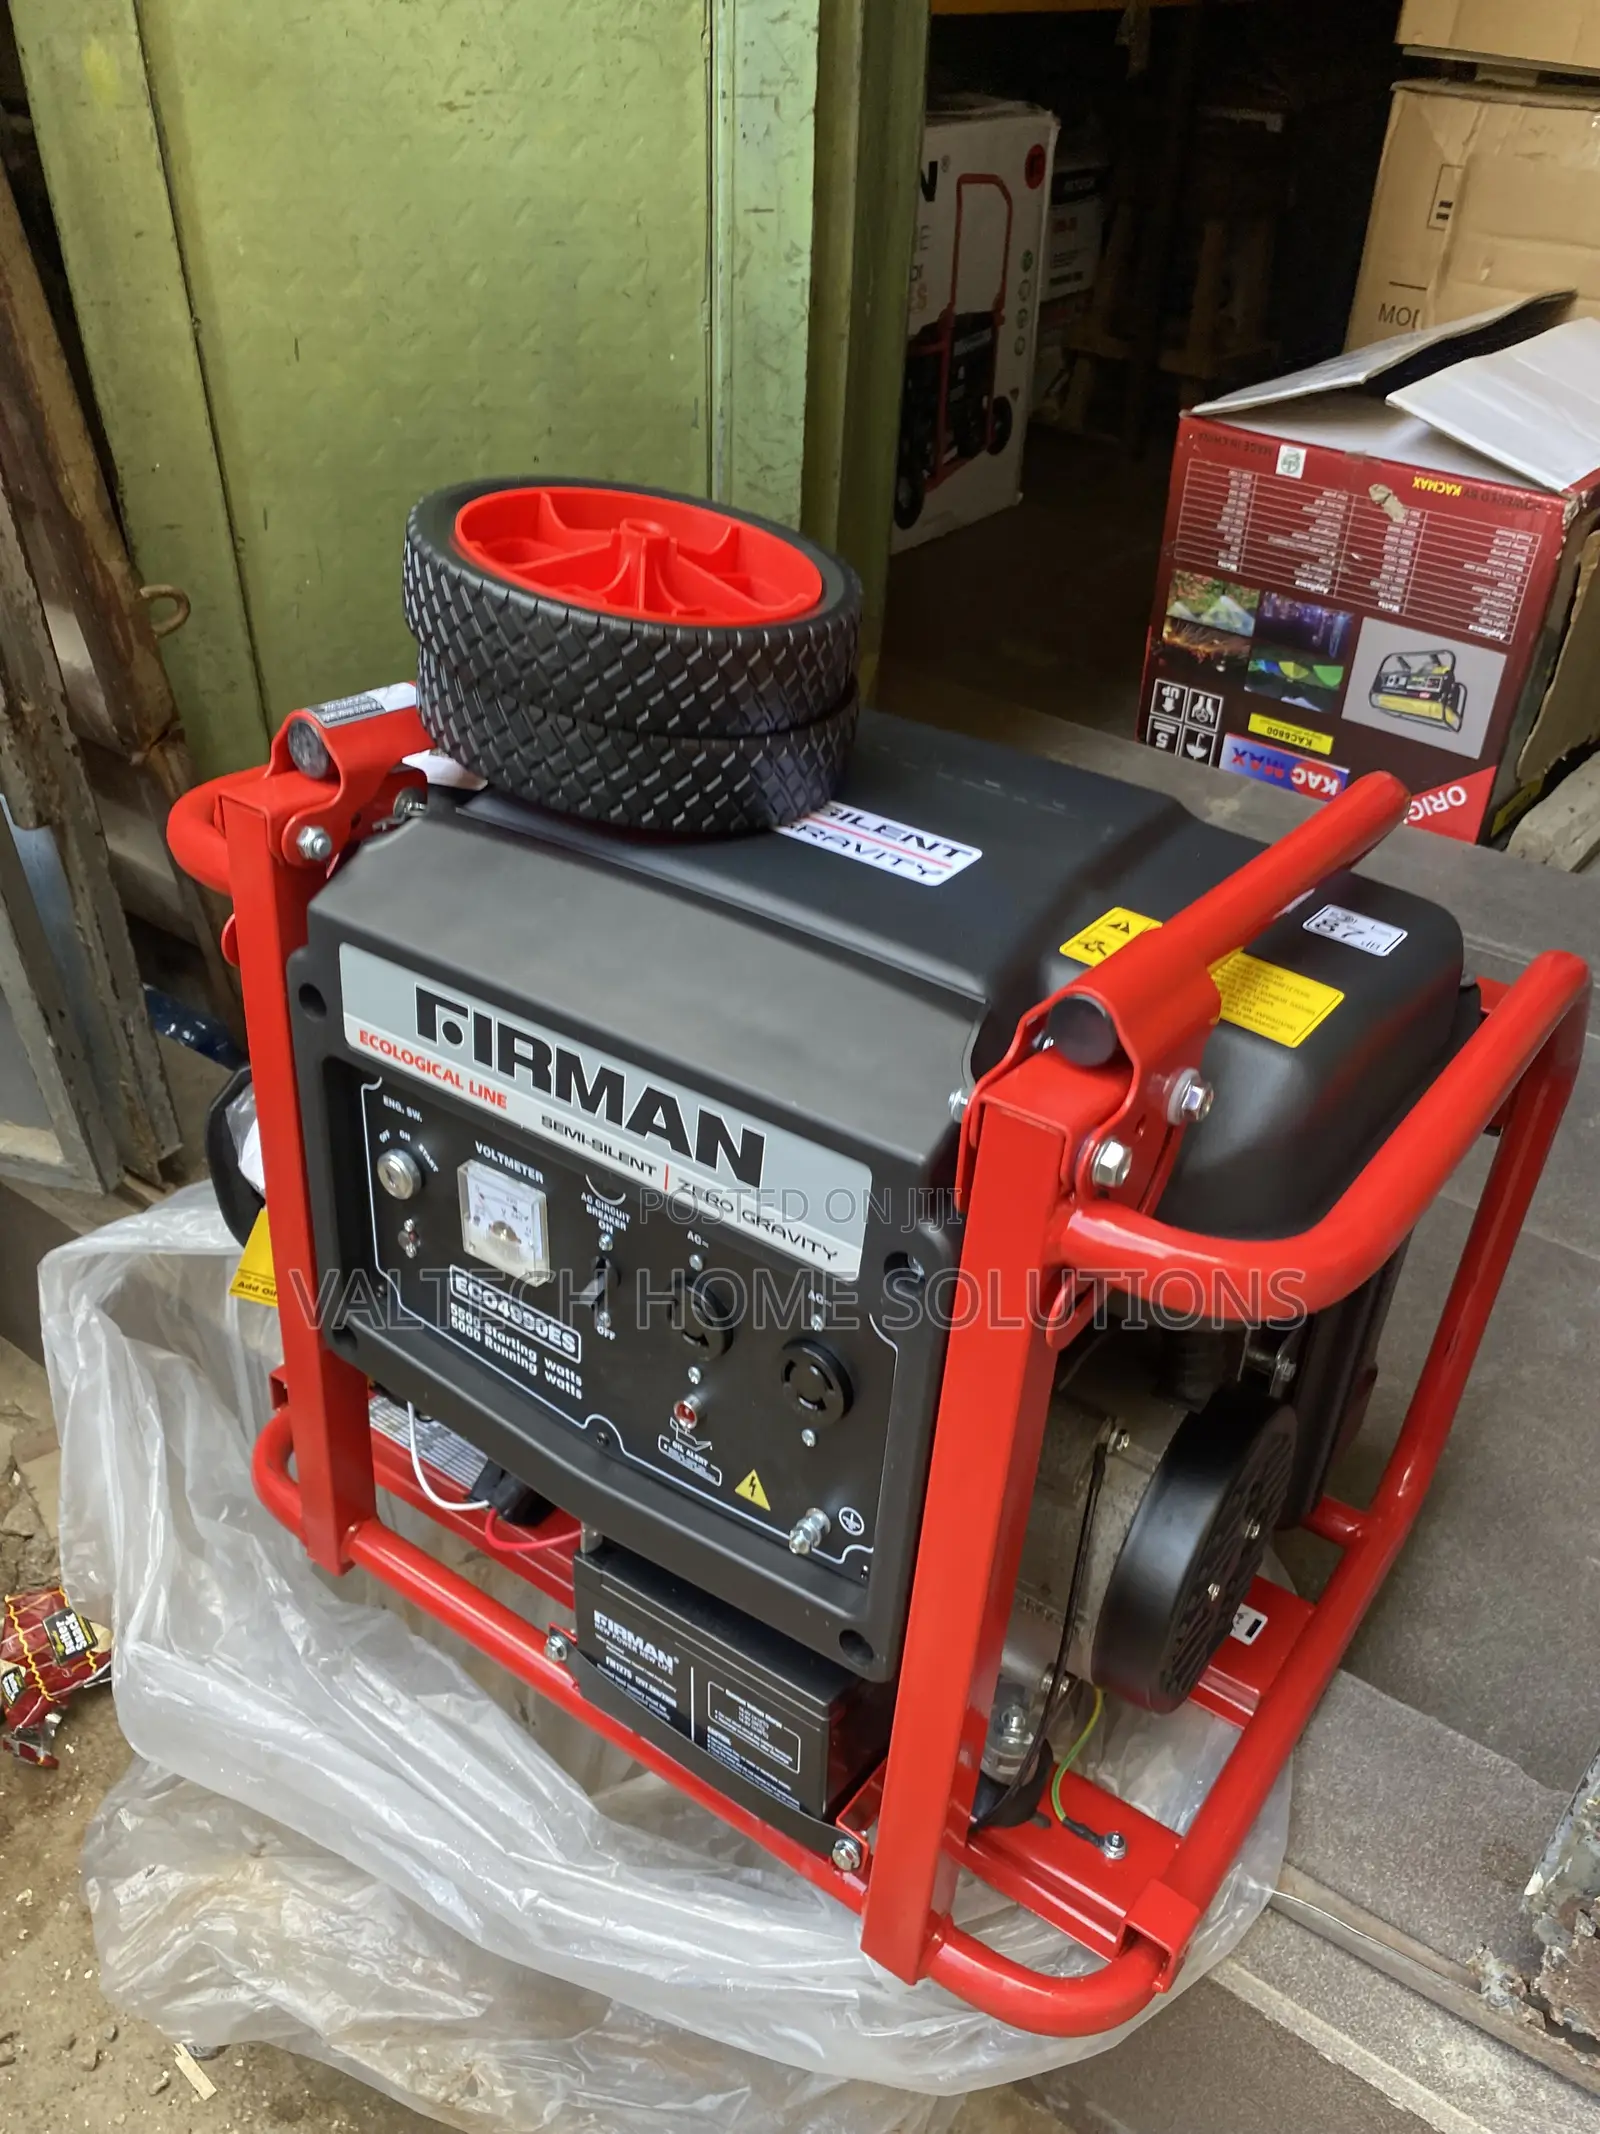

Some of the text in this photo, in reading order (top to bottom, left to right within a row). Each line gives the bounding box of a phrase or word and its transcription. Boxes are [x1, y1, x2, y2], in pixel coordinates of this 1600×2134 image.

[1411, 475, 1463, 498] KACMAX
[1376, 600, 1400, 613] Watts
[1161, 683, 1181, 700] UP
[1154, 733, 1169, 750] 5
[1231, 747, 1342, 796] KAC MAX
[359, 1030, 508, 1109] ECOLOGICAL LINE
[415, 983, 765, 1187] FIRMAN
[399, 1130, 411, 1142] ON
[418, 1143, 439, 1173] START
[475, 1140, 543, 1184] VOLTMETER
[541, 1114, 838, 1260] SEMI-SILENT ZERO GRAVITY
[580, 1192, 631, 1224] AC CIRCUIT
[585, 1204, 627, 1232] BREAKER
[598, 1220, 613, 1236] ON
[238, 1281, 259, 1292] Add
[596, 1326, 615, 1341] OFF
[484, 1323, 537, 1364] Starting
[544, 1356, 582, 1388] watts
[484, 1334, 537, 1377] Running
[544, 1369, 582, 1401] watts
[672, 1440, 685, 1453] OIL
[686, 1448, 709, 1467] ALERT
[65, 1613, 87, 1651] Snack
[594, 1610, 673, 1670] FIRMAN
[613, 1633, 637, 1653] POWER
